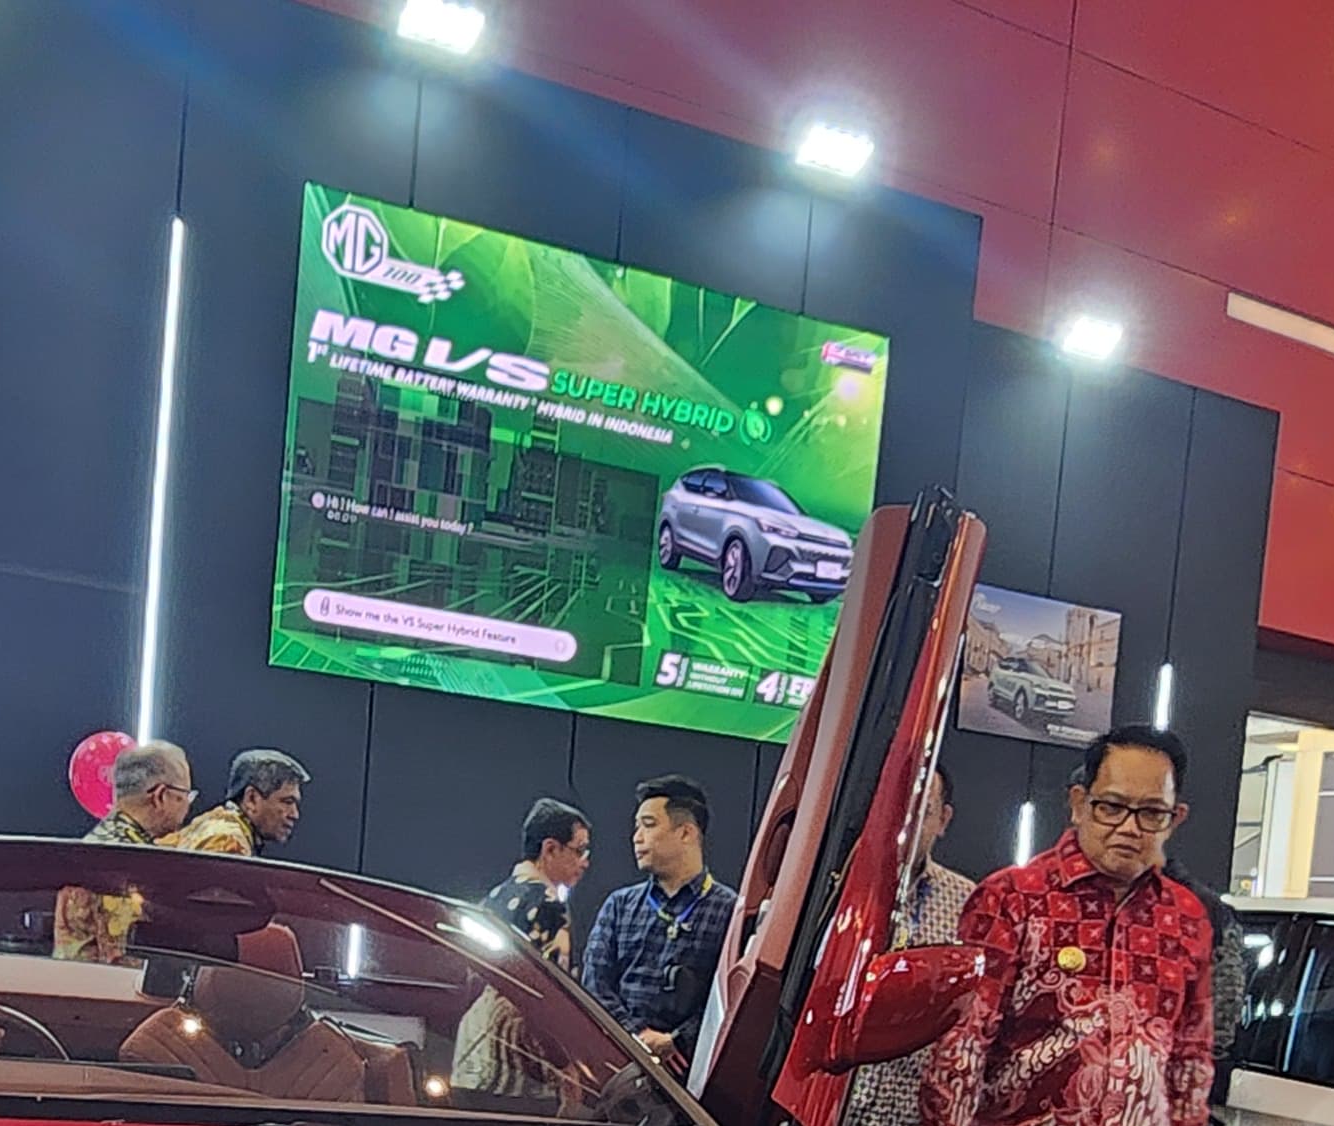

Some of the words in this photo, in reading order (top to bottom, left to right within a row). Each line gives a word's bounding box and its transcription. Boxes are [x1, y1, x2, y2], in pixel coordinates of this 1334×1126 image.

[327, 209, 384, 277] MG
[383, 266, 422, 284] 100
[309, 309, 418, 362] MG
[551, 371, 639, 410] SUPER
[641, 391, 735, 433] HYBRID
[329, 353, 395, 379] LIFETIME
[536, 400, 586, 424] HYBRID
[587, 411, 604, 428] IN
[603, 416, 673, 444] INDONESIA
[336, 604, 363, 617] Show
[365, 611, 381, 621] me
[383, 612, 399, 624] the
[417, 617, 445, 632] Super
[447, 622, 480, 638] Hybrid
[656, 652, 682, 685] 5
[755, 671, 780, 703] 4
